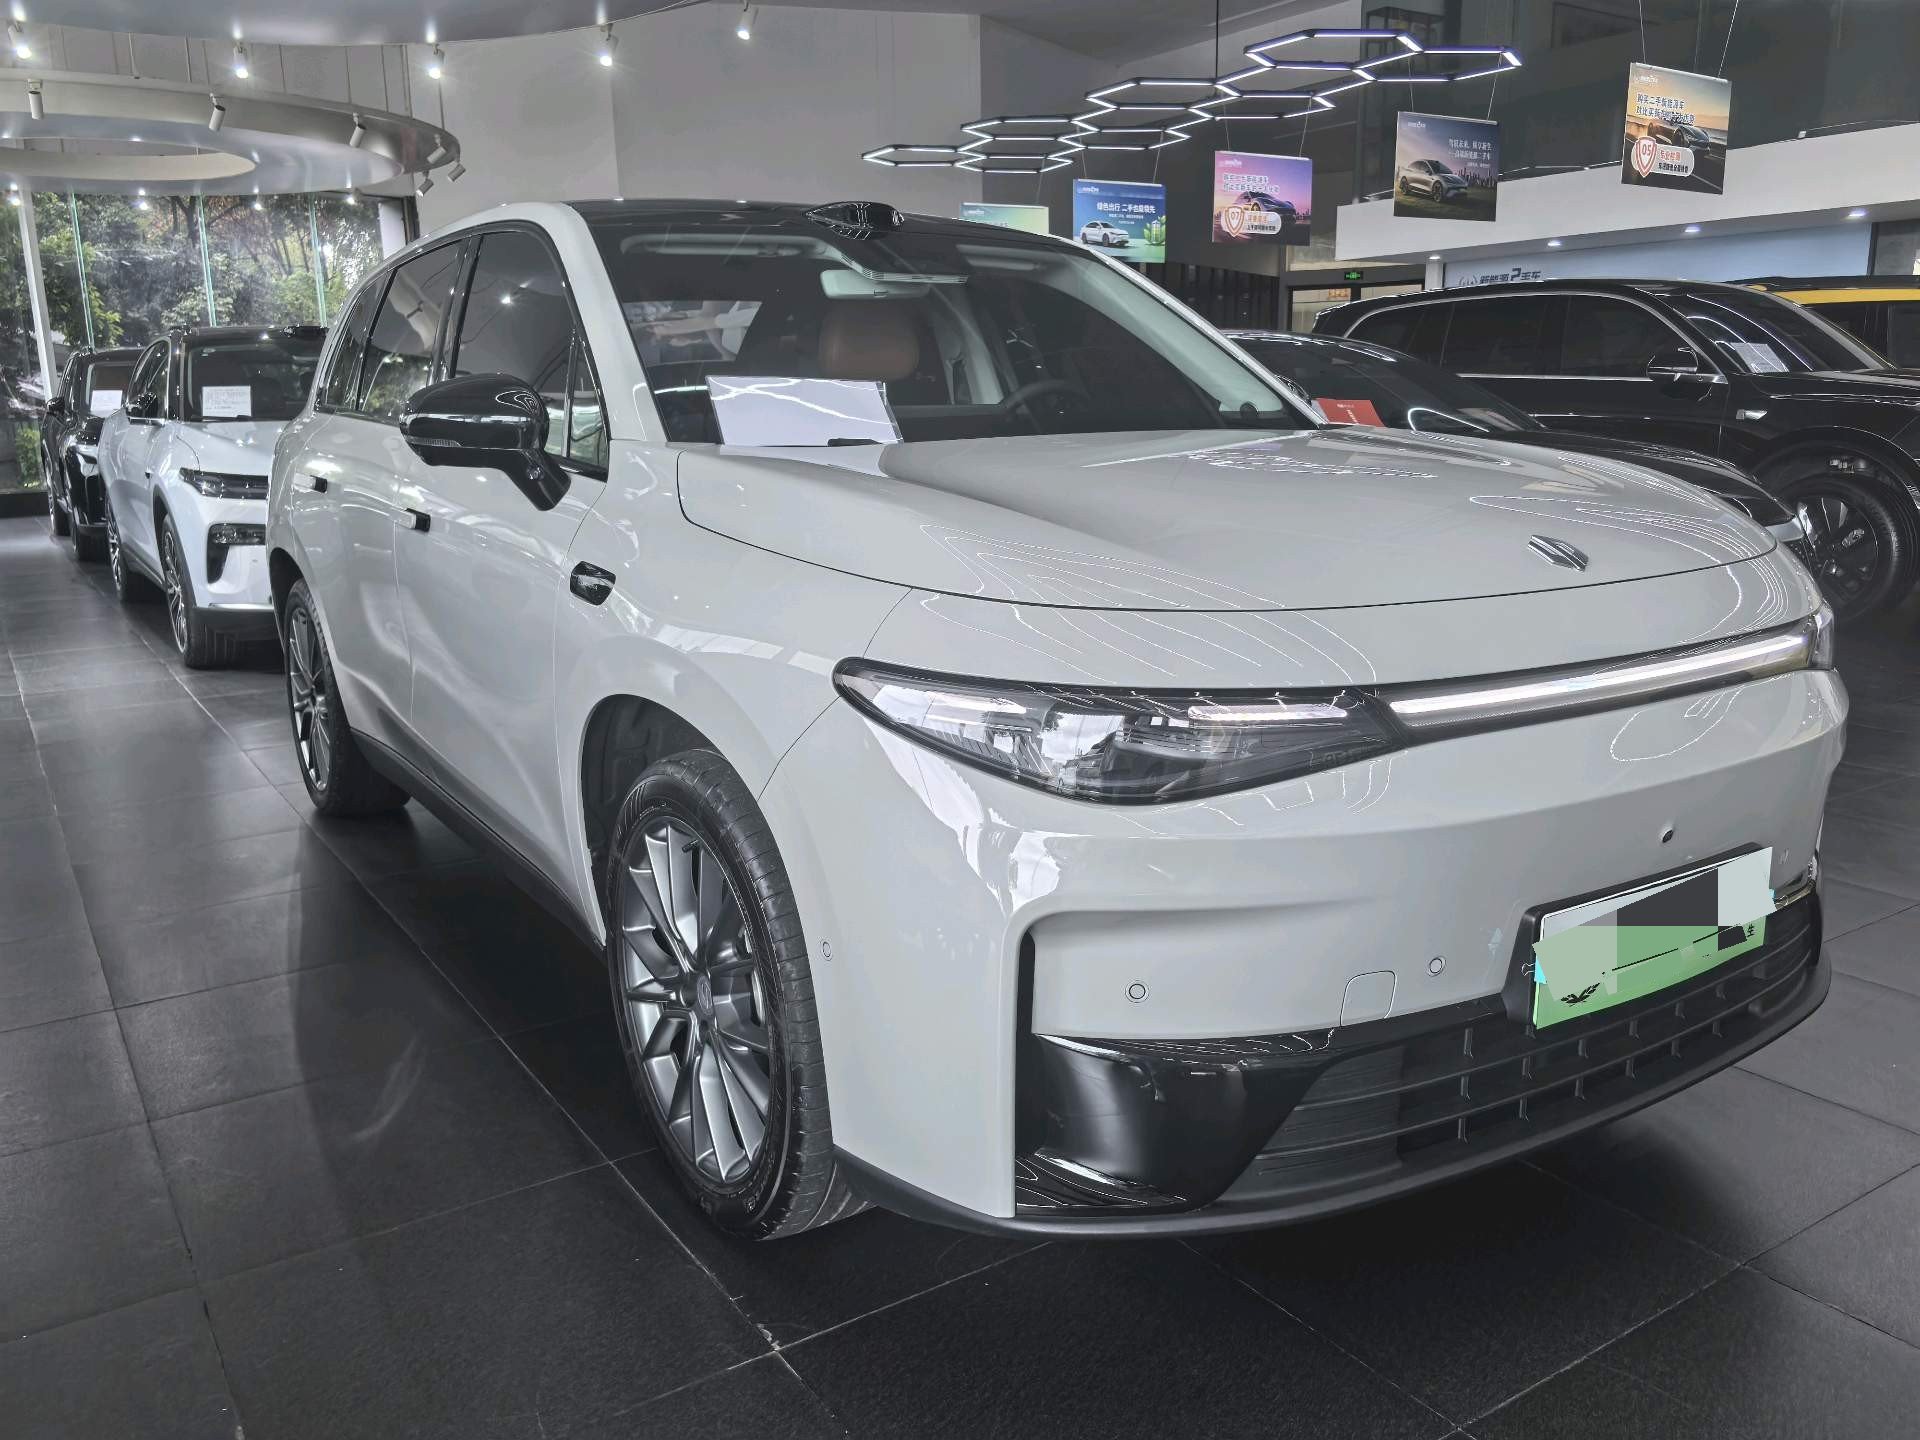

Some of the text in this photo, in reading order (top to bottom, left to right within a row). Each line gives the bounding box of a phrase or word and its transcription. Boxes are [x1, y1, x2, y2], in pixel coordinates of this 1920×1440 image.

[1642, 143, 1653, 156] 05
[1096, 201, 1120, 212] 绿色出行
[1230, 211, 1240, 220] 07
